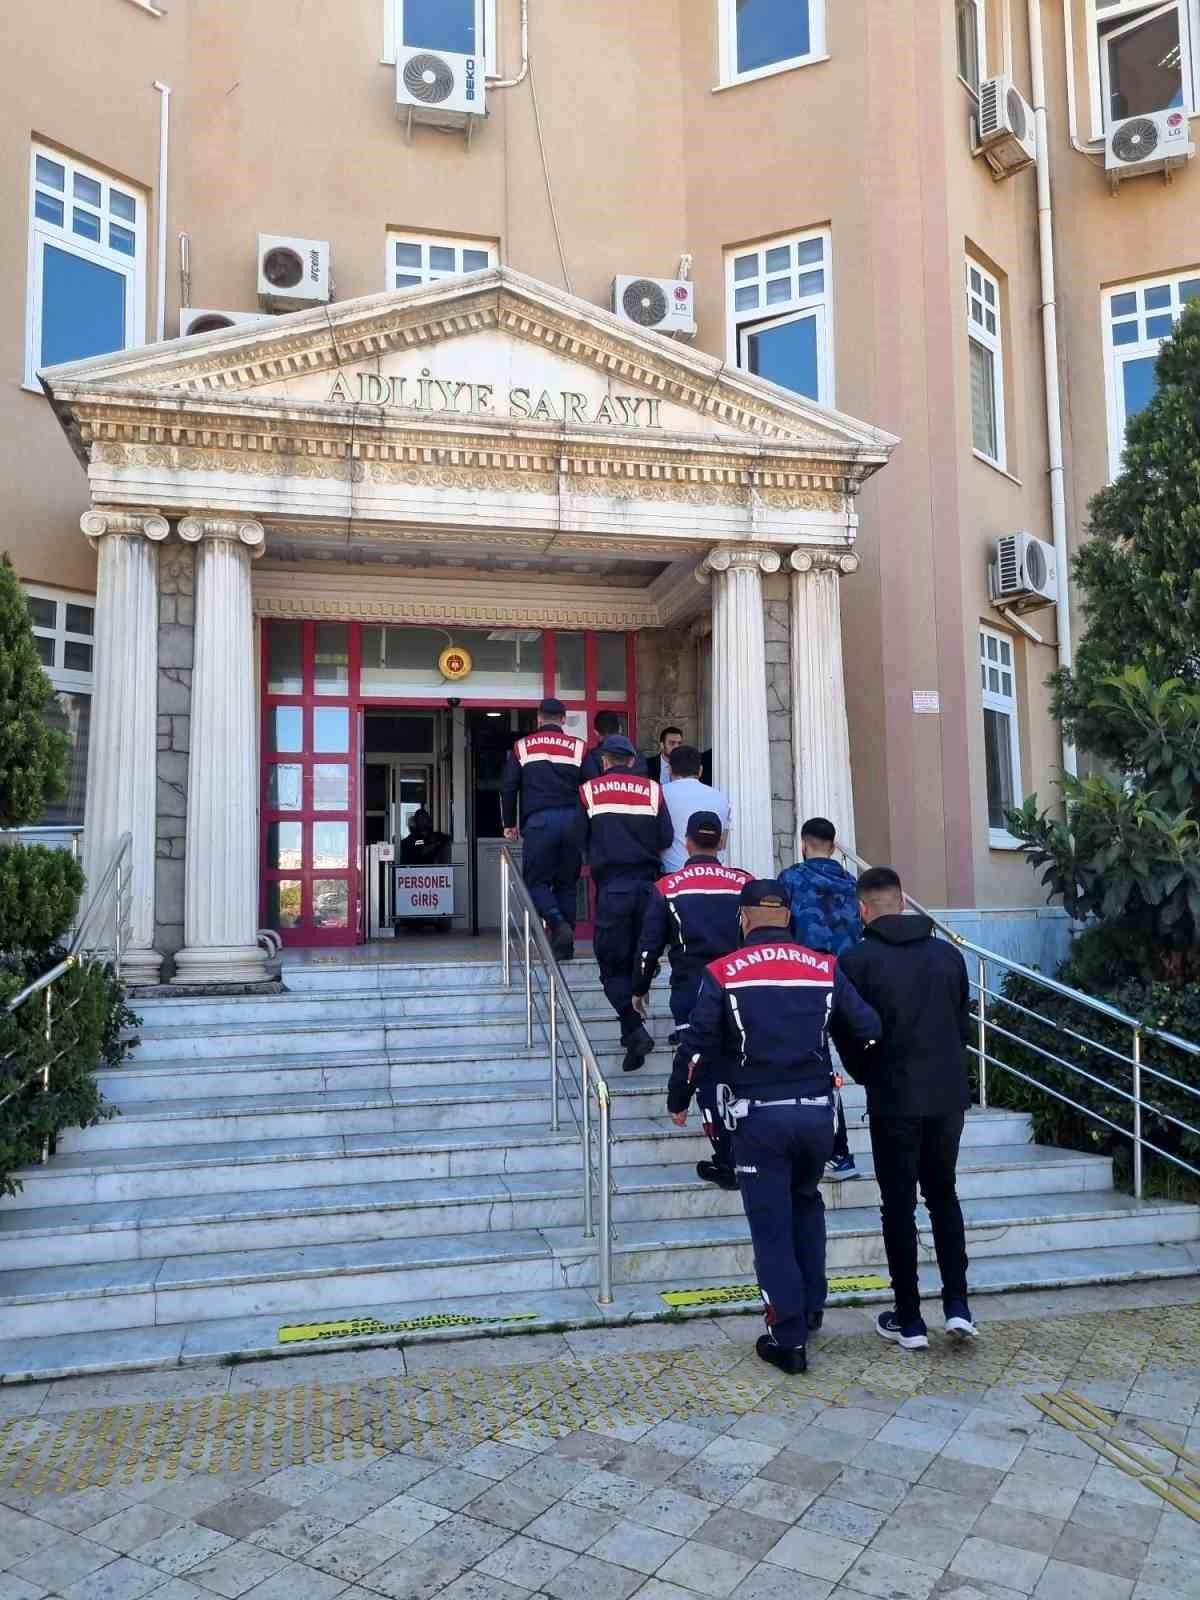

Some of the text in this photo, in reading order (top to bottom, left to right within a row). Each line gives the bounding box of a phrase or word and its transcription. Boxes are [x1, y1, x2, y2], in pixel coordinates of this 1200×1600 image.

[465, 59, 475, 101] BEKO
[1168, 127, 1182, 137] LG
[675, 303, 687, 311] LG
[328, 368, 663, 429] ADLİYE SARAYI
[526, 736, 576, 752] JANDARMA
[592, 780, 650, 797] JANDARMA
[398, 875, 451, 889] PERSONEL
[667, 866, 746, 889] JANDARMA
[411, 890, 439, 910] GİRİŞ
[725, 947, 830, 977] JANDARMA
